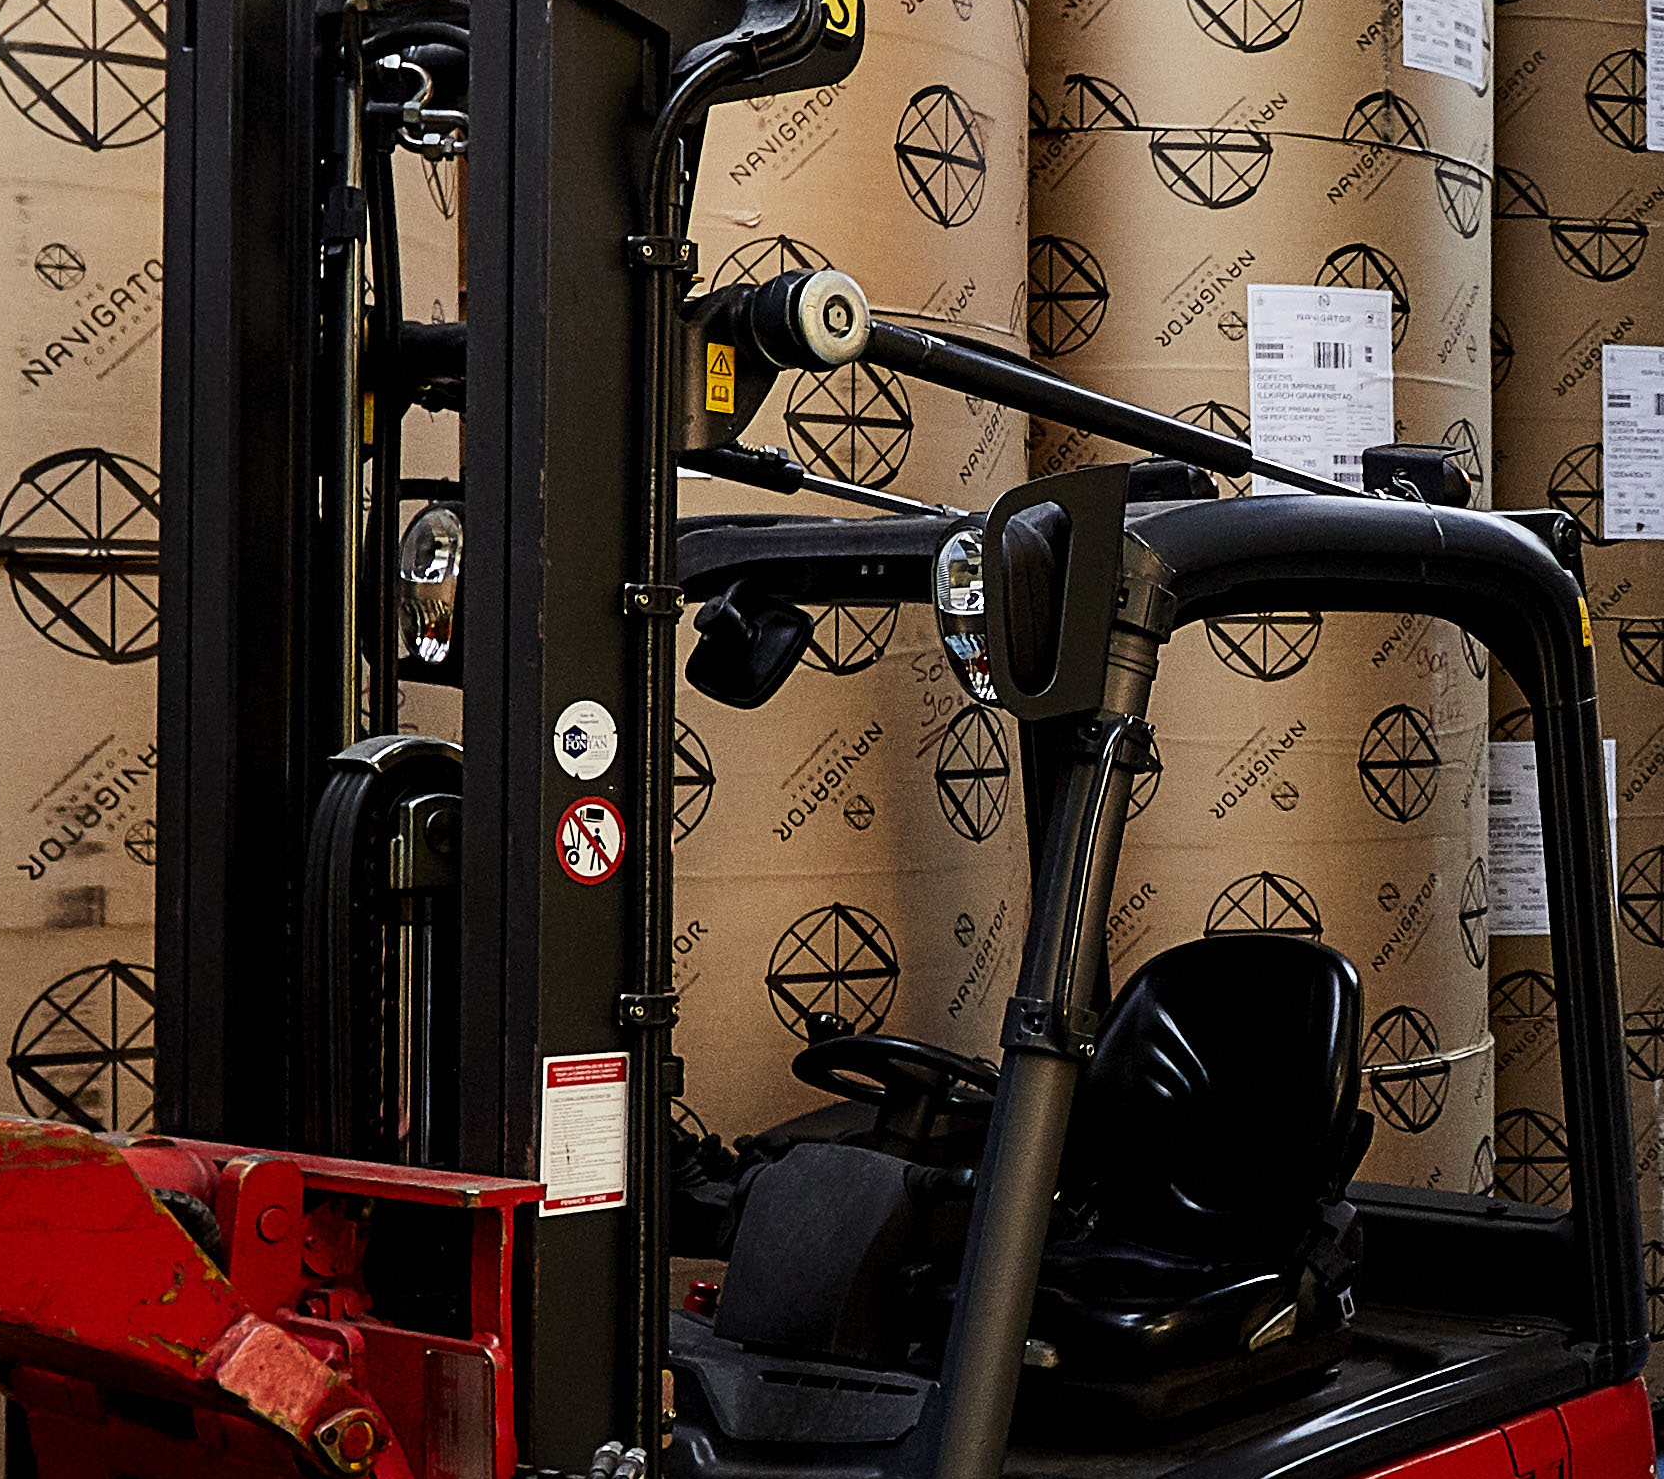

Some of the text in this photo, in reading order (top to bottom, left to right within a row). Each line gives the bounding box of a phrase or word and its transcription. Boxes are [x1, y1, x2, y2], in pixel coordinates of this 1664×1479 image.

[730, 82, 848, 185] NAVIGATOR
[1158, 249, 1255, 348] NAVIGATOR
[774, 723, 883, 841] NAVIGATOR
[1208, 720, 1307, 820] NAVIGATOR
[949, 900, 1008, 1018] NAVIGATOR
[1372, 873, 1438, 971] NAVIGATOR
